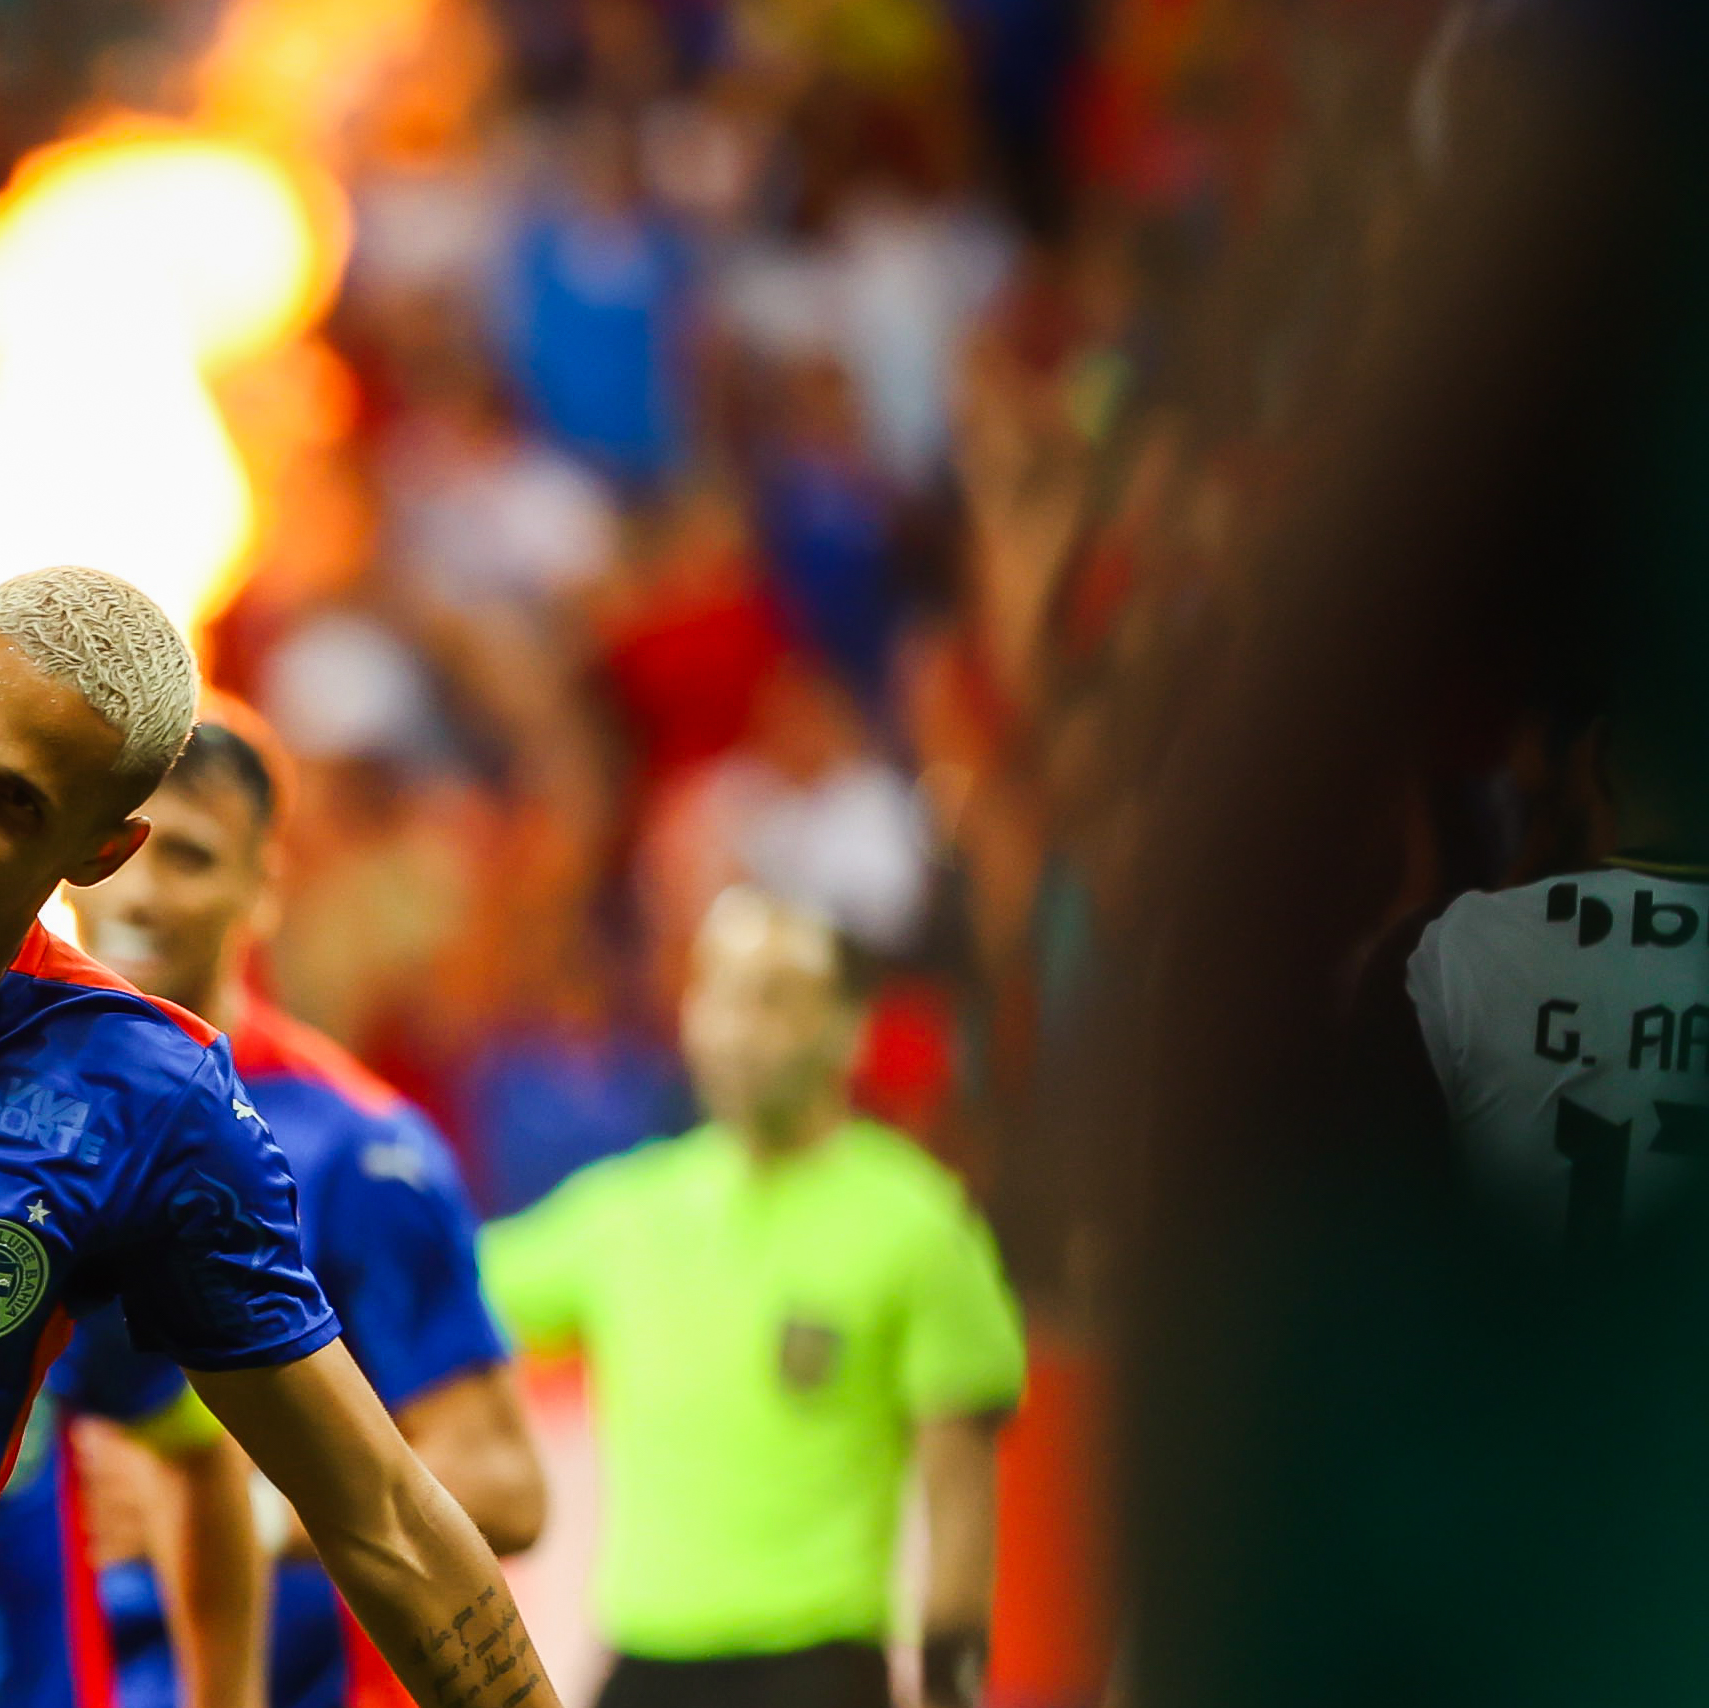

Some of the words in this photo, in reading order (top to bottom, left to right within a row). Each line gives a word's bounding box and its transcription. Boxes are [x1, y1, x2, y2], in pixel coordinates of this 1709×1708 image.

[1535, 999, 1596, 1065] G.
[6, 1076, 90, 1129] VIVA
[5, 1268, 39, 1318] BAHIA
